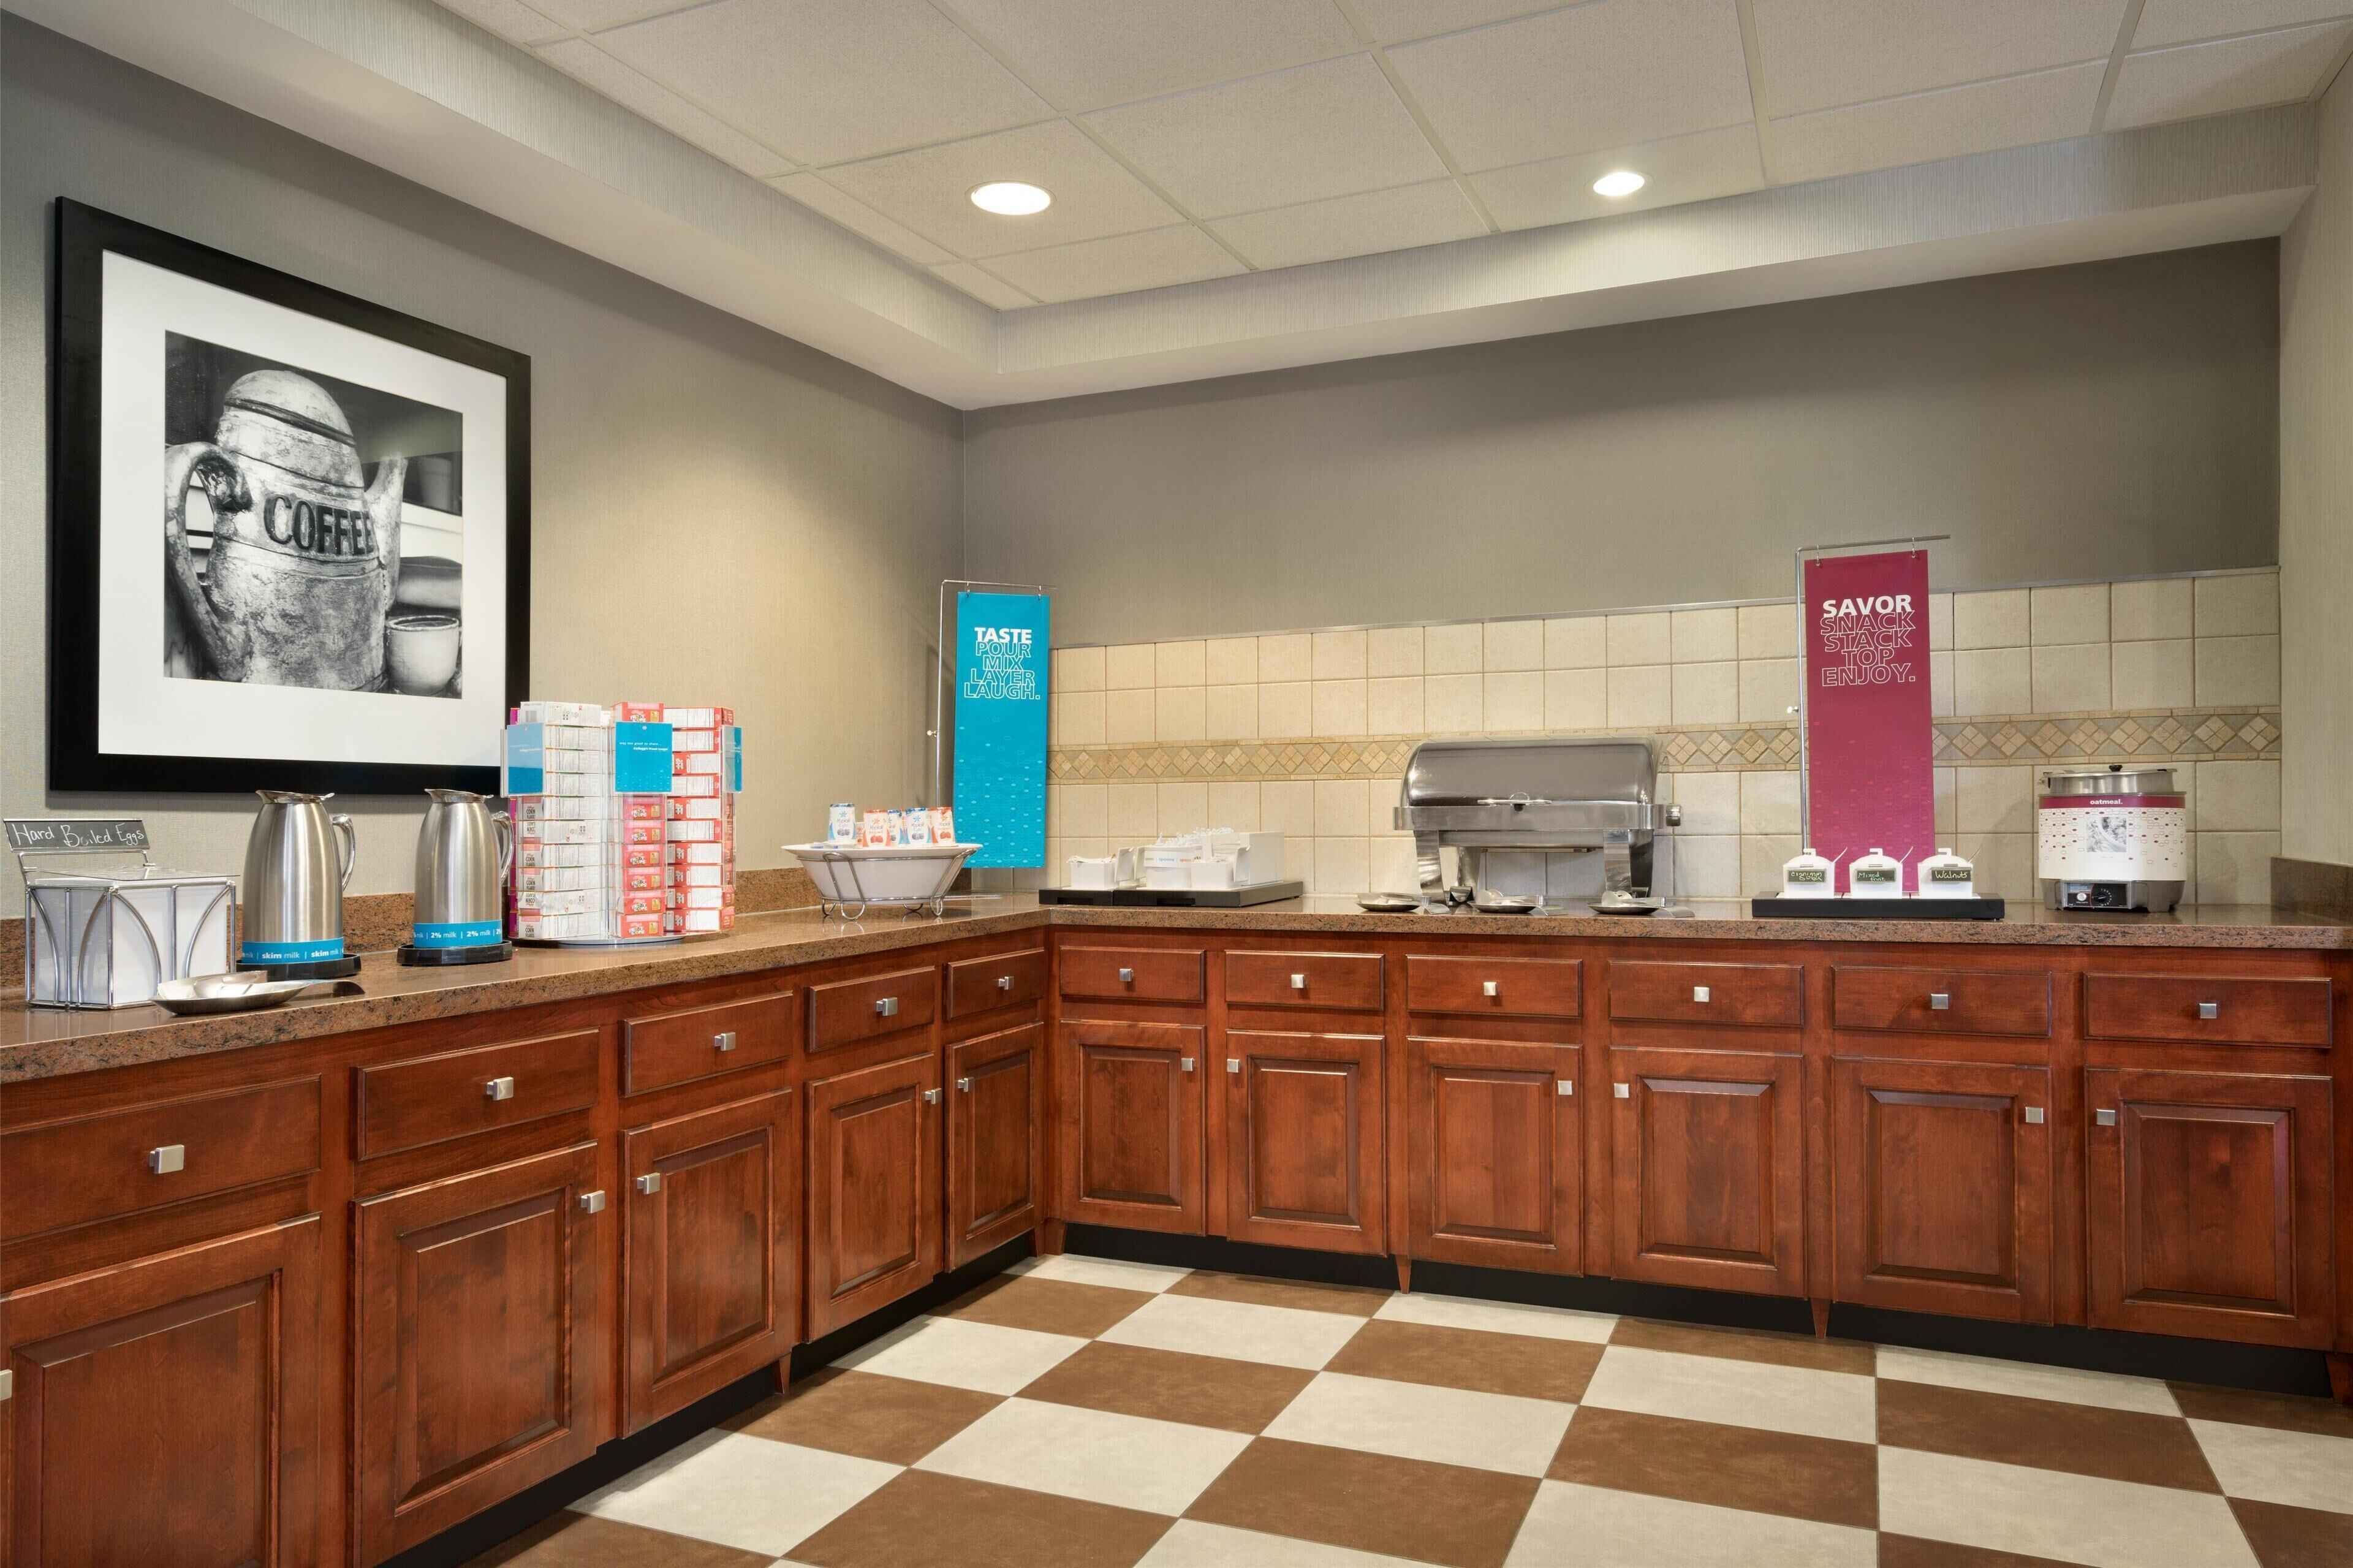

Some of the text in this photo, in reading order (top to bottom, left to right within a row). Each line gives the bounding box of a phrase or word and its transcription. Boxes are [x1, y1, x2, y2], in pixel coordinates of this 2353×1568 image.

[264, 495, 374, 555] COFFEE
[1822, 594, 1912, 618] SAVOR
[1820, 610, 1916, 635] SNACK
[974, 627, 1032, 643] TASTE
[1824, 628, 1912, 652] STACK
[976, 640, 1031, 657] POUR
[1841, 646, 1895, 667] TOP
[983, 654, 1023, 670] MIX
[971, 668, 1035, 685] LAYER
[1822, 663, 1915, 686] ENJOY.
[964, 682, 1040, 700] LAUGH.
[12, 824, 55, 846] Hard
[116, 822, 145, 845] Eggs
[1935, 870, 1968, 879] Walnuts
